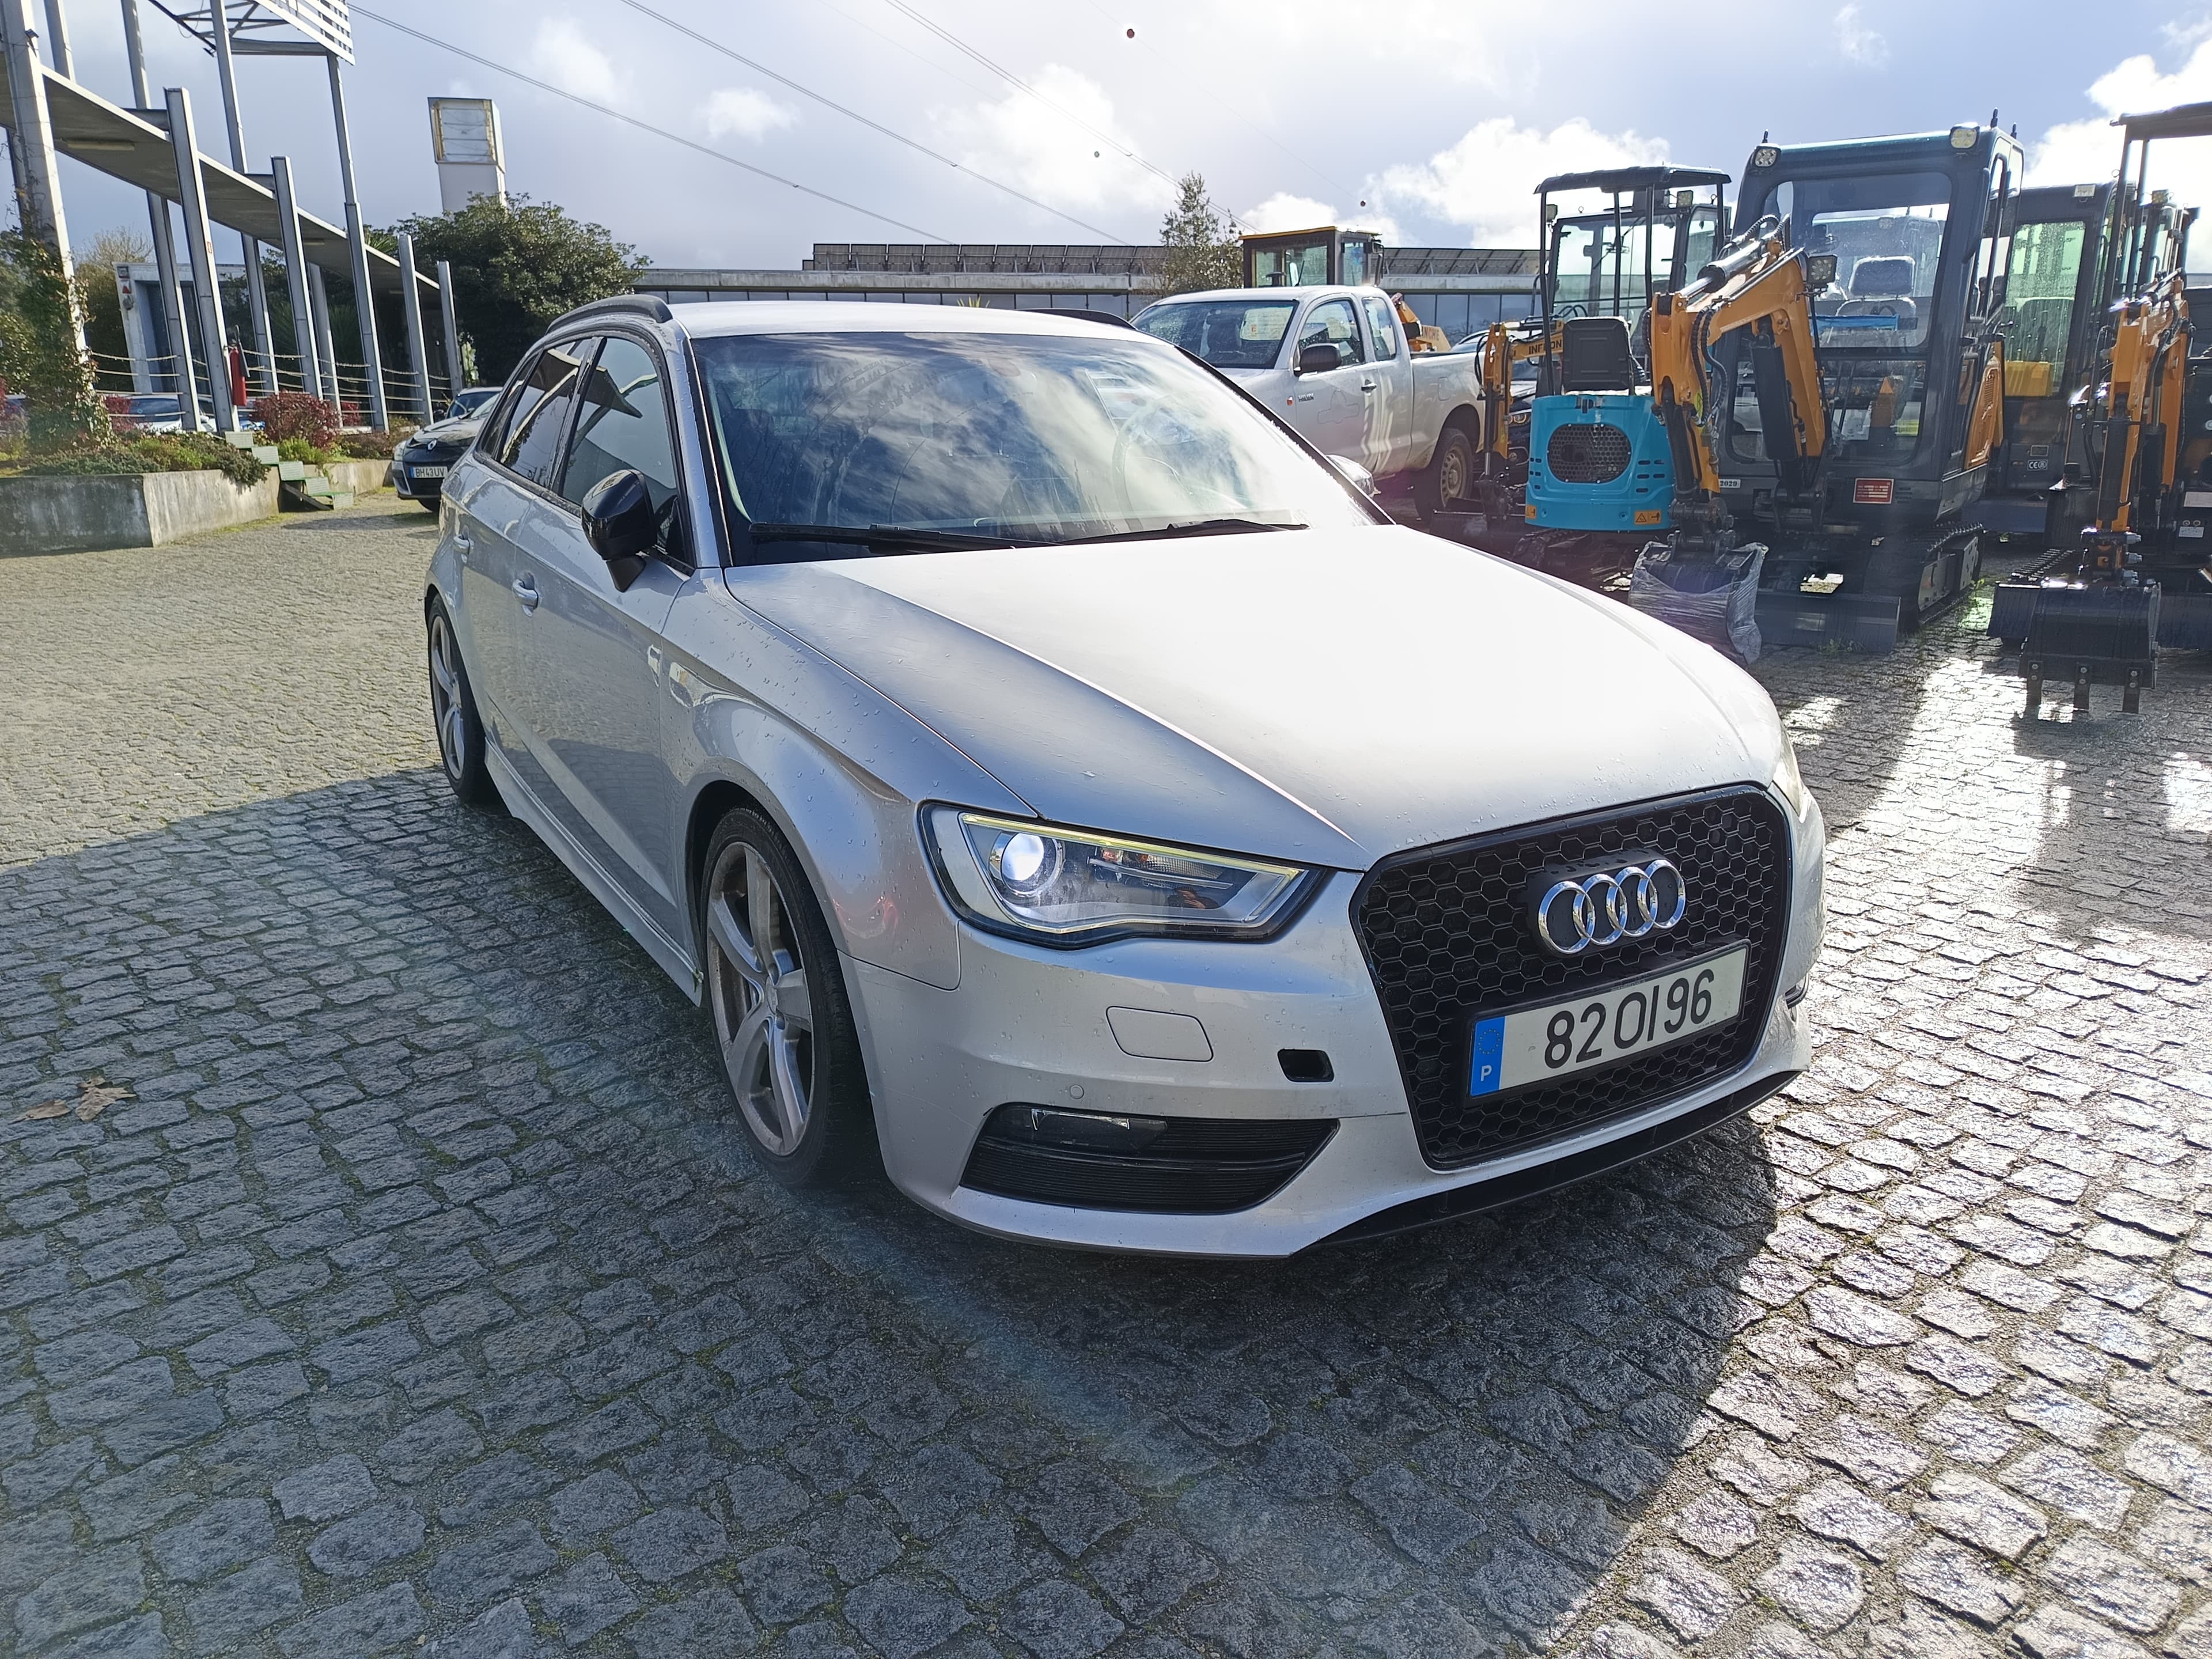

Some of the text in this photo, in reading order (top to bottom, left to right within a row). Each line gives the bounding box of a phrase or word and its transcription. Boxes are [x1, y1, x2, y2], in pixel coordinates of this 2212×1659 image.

[1528, 339, 1562, 354] INFON
[415, 468, 444, 477] BH43UV
[1480, 1065, 1492, 1082] P
